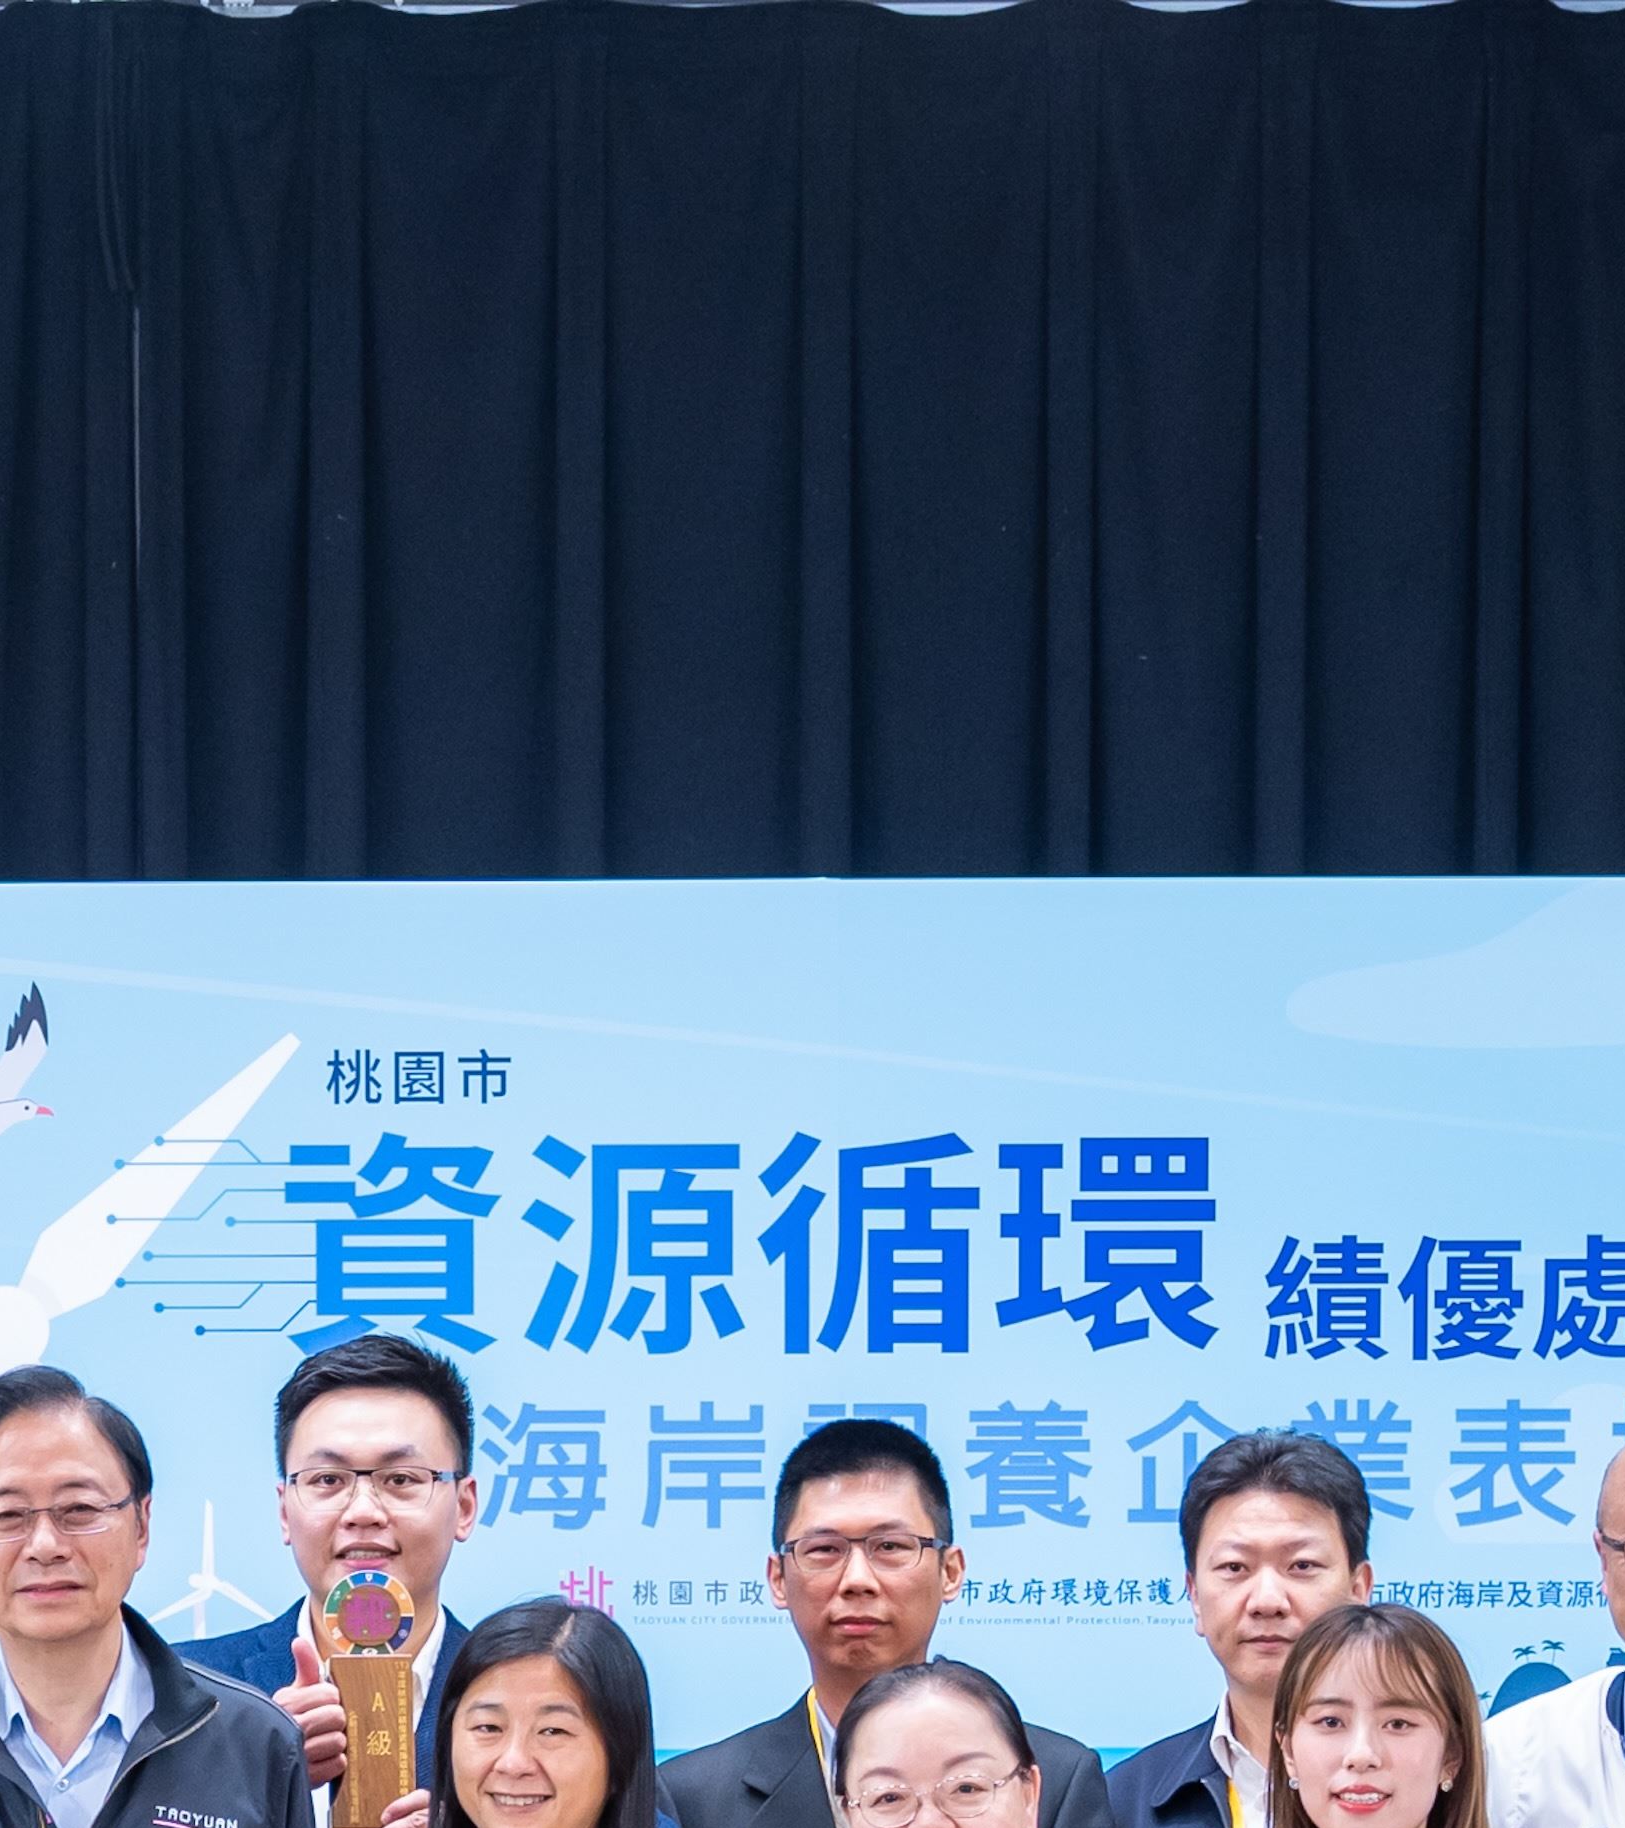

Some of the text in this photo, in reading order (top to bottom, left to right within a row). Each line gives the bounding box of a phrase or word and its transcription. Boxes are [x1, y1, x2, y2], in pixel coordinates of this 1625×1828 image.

[326, 1048, 512, 1105] 桃園市
[283, 1131, 1220, 1355] 資源循環
[960, 1577, 1187, 1607] 市政府環境保護
[633, 1615, 686, 1625] TAOYUAN
[691, 1615, 716, 1625] CITY
[958, 1615, 1061, 1625] Environmental
[366, 1730, 392, 1757] 級
